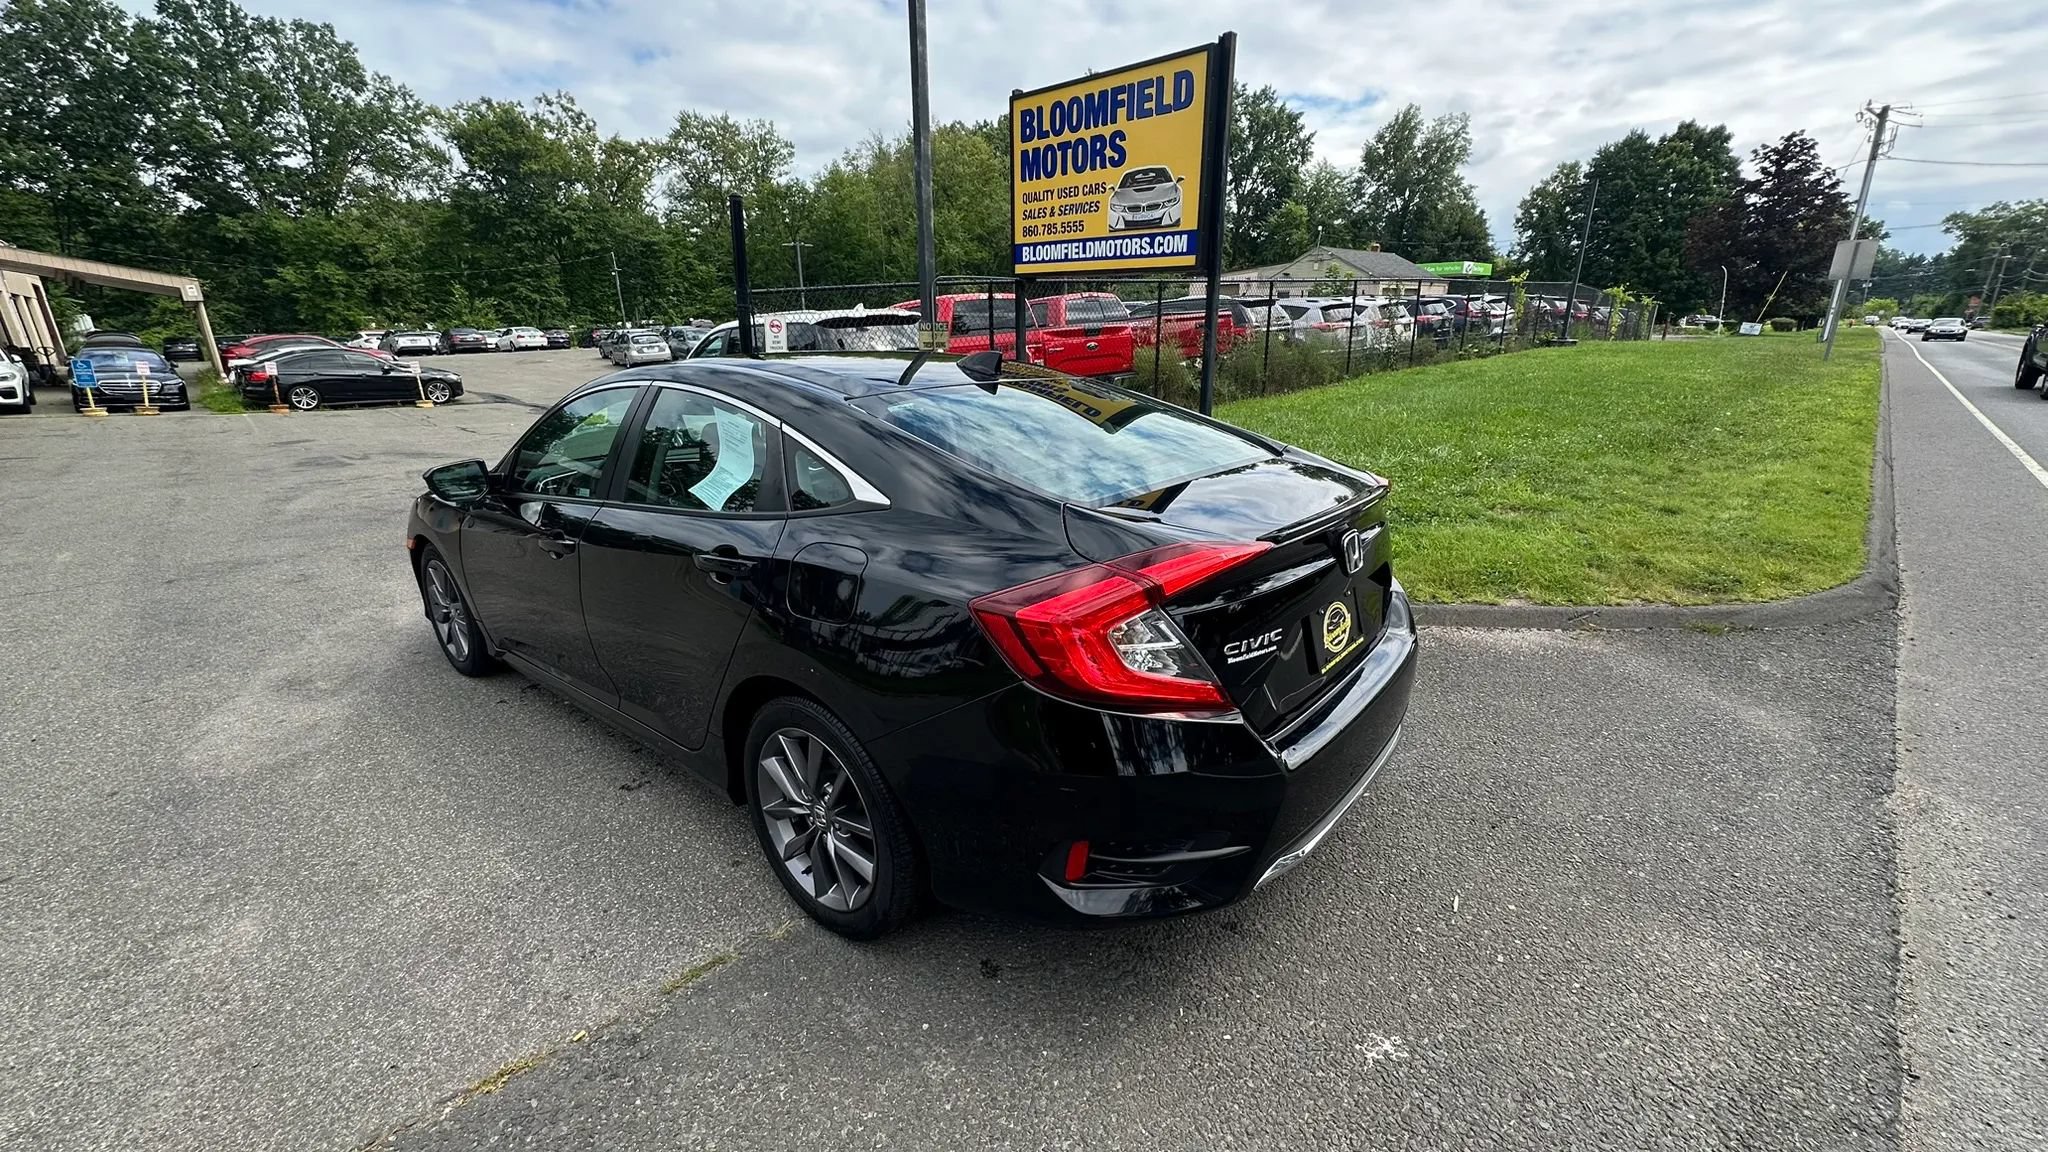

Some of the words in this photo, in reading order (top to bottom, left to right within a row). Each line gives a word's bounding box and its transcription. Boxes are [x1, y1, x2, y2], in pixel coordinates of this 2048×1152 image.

[1020, 69, 1195, 143] BLOOMFIELD
[1020, 129, 1127, 182] MOTORS
[1022, 189, 1055, 205] QUALITY
[1057, 185, 1079, 199] USED
[1082, 181, 1107, 196] CARS
[1022, 207, 1047, 221] SALES
[1049, 205, 1056, 217] &
[1058, 200, 1100, 216] SERVICES
[1022, 220, 1084, 238] 860.785.5555
[1022, 234, 1188, 262] BLOOMFIELDMOTORS.COM
[920, 322, 948, 331] NOICE
[1224, 628, 1282, 655] CIVIC
